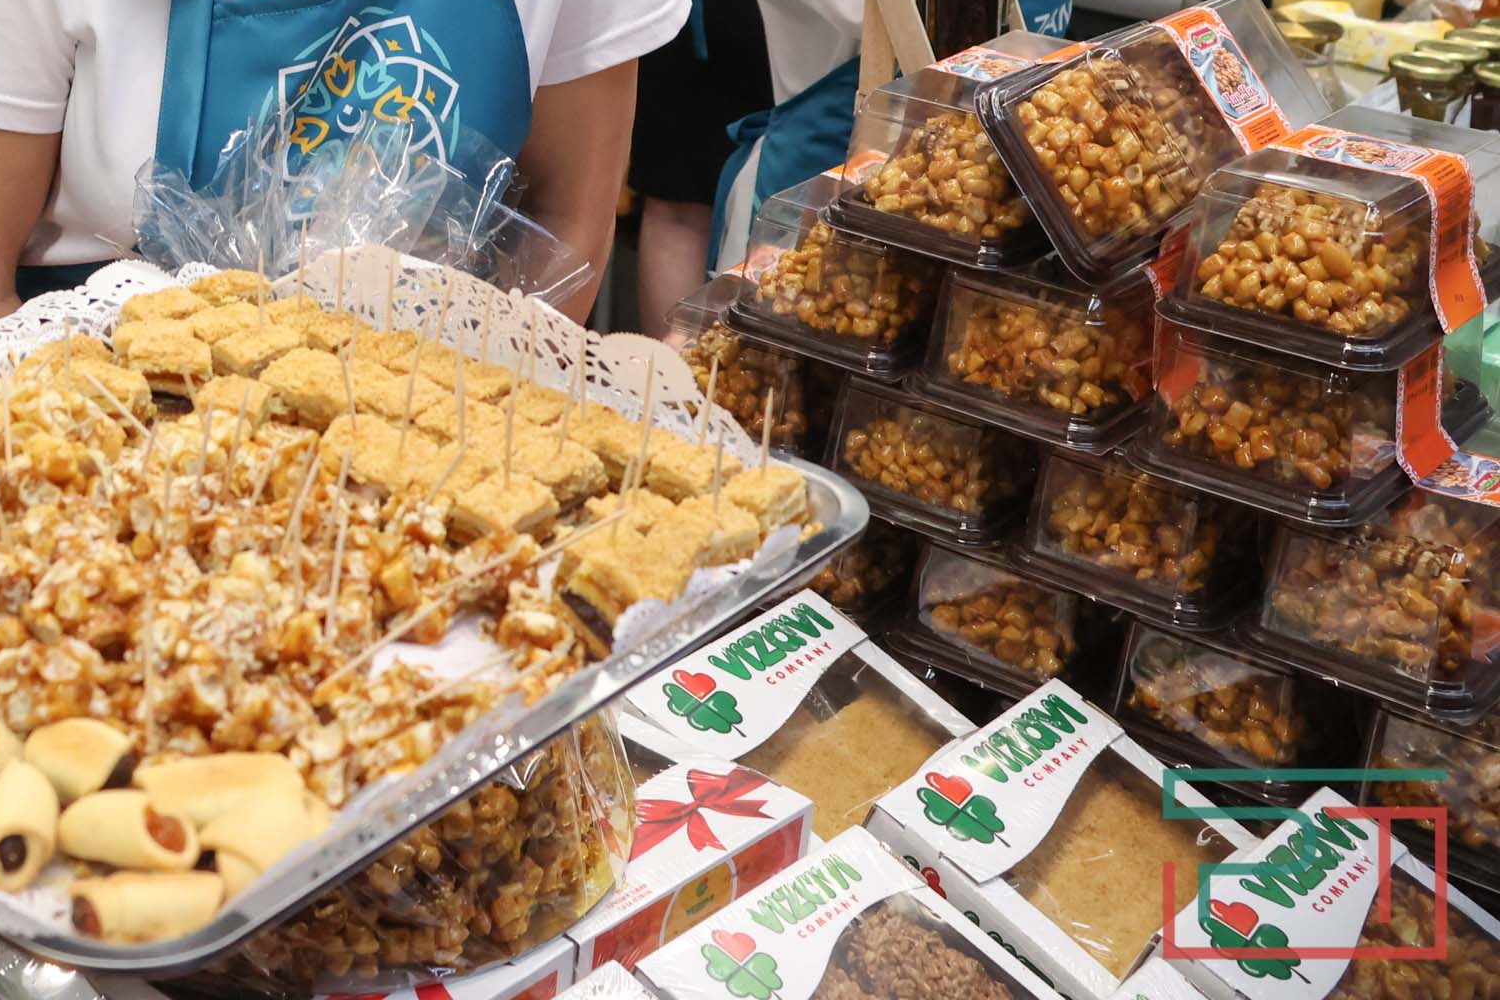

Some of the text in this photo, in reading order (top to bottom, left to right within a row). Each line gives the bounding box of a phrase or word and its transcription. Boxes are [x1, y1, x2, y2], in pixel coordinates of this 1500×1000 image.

[766, 642, 832, 685] COMPANY
[1312, 856, 1375, 913] COMPANY
[797, 894, 859, 938] COMPANY
